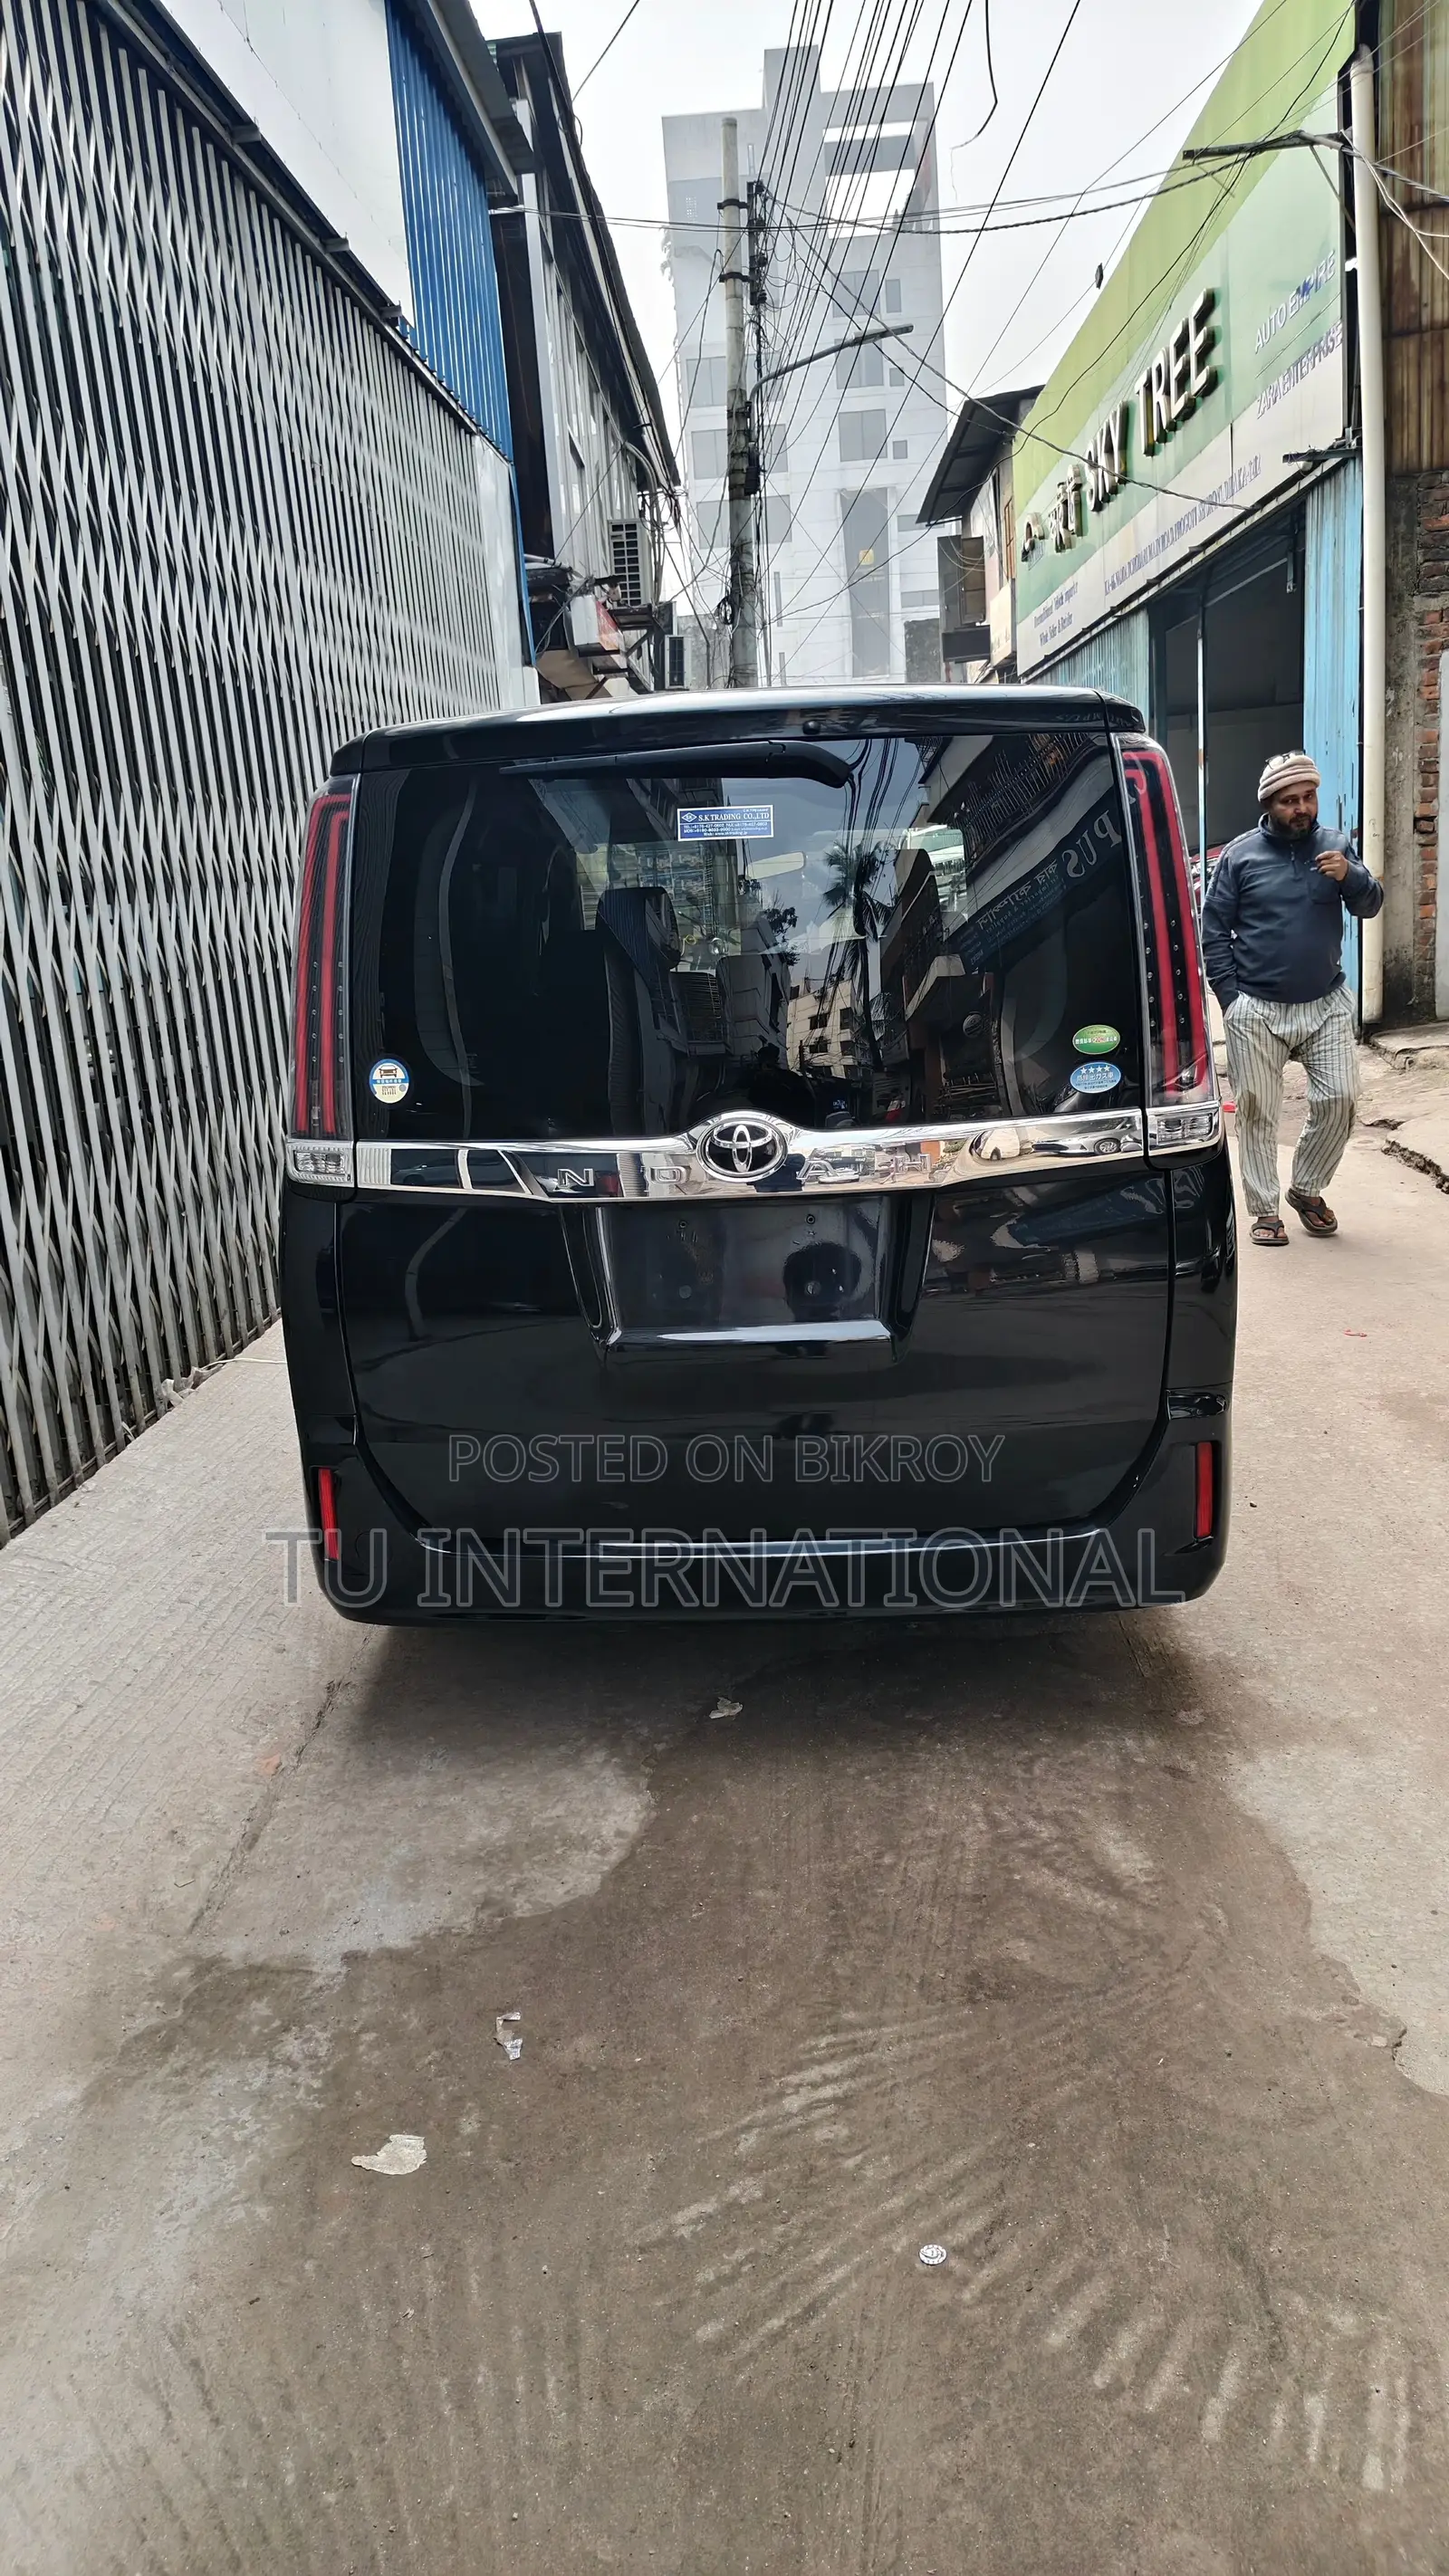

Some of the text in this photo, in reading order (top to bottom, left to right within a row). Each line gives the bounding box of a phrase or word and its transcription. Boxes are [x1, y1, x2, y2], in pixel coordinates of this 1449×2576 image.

[1255, 249, 1336, 354] AUTO EMPIRE
[1085, 400, 1130, 512] SKY
[1135, 288, 1220, 457] TREE
[710, 812, 741, 821] TRADING
